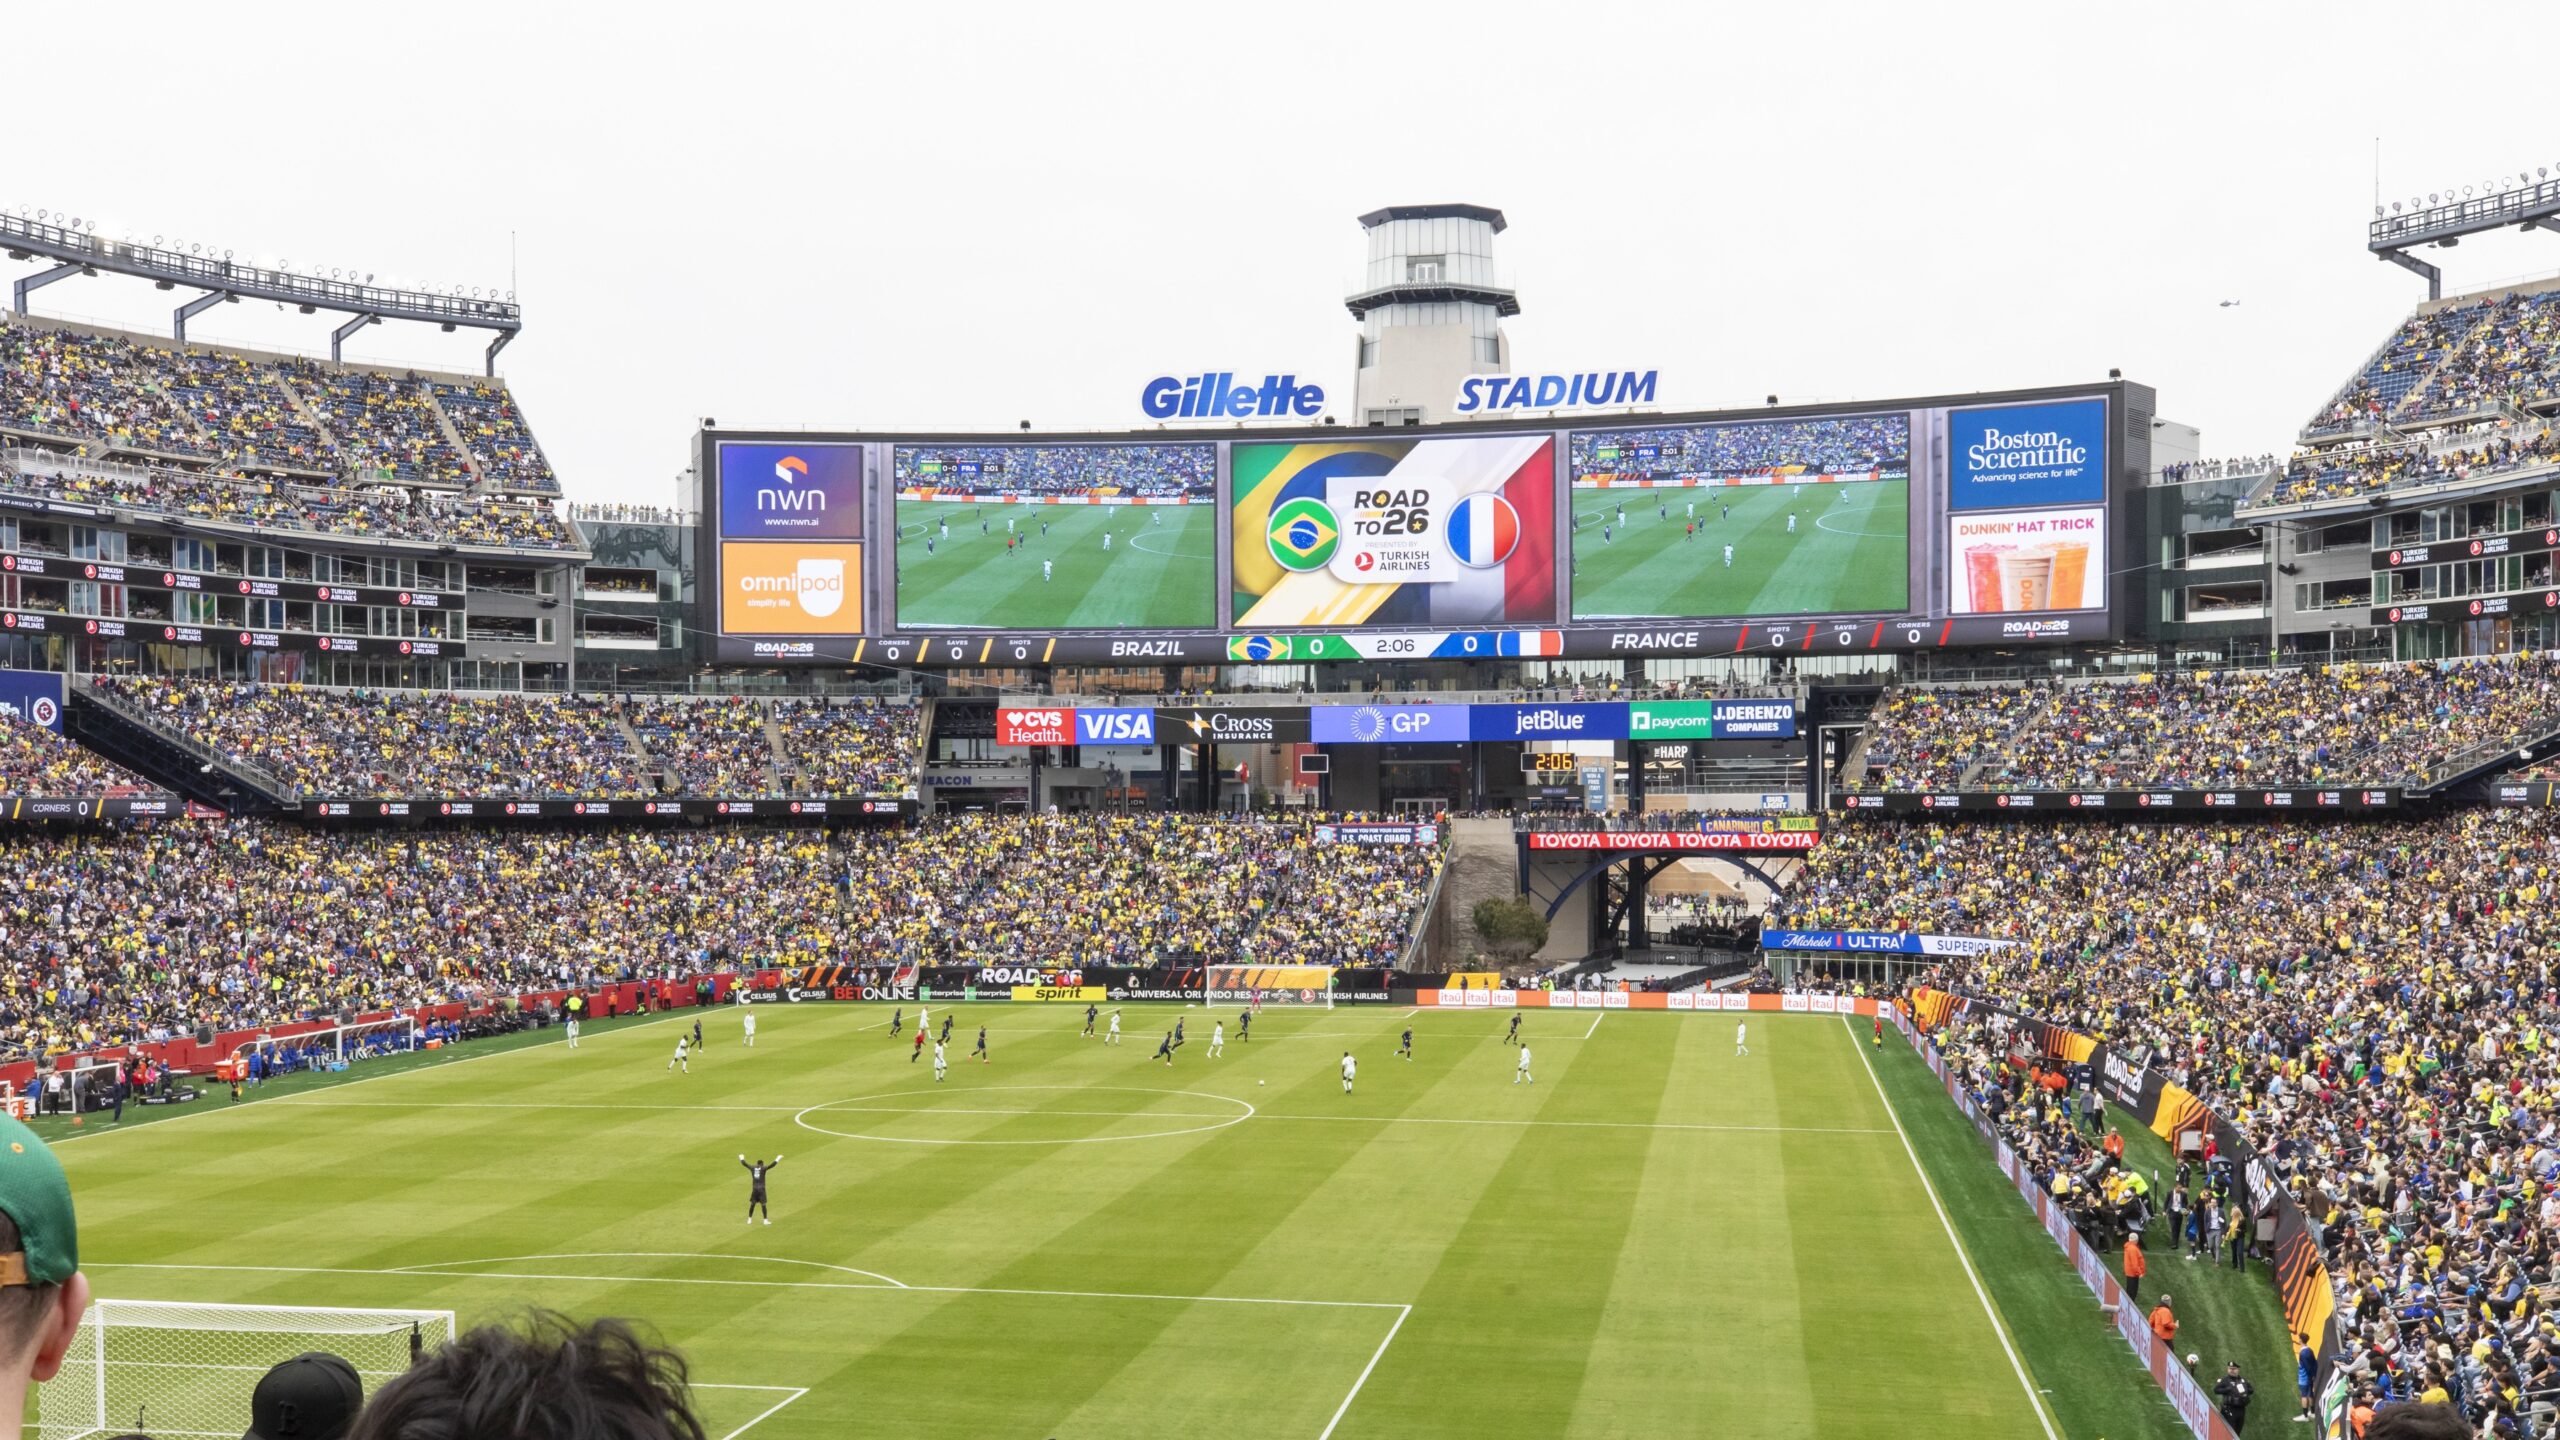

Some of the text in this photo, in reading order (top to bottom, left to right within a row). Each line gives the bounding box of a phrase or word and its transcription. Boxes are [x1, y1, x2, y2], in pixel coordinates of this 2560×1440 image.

[1142, 372, 1325, 418] Gillette
[1457, 371, 1658, 411] STADIUM
[1985, 428, 2058, 449] Boston
[1969, 439, 2086, 470] Scientific
[1972, 472, 2013, 483] Advancing
[2015, 470, 2047, 480] science
[2048, 468, 2061, 477] for
[757, 488, 825, 511] nwn
[1354, 490, 1430, 509] ROAD
[765, 517, 819, 527] www.nwn.ai
[1354, 520, 1381, 535] TO
[1960, 518, 2095, 535] DUNKIN' HAT TRICK
[2483, 538, 2508, 547] TURKISH
[2483, 544, 2508, 553] AIRLINES
[1379, 550, 1430, 560] TURKISH
[2402, 548, 2428, 557] TURKISH
[2402, 554, 2428, 563] AIRLINES
[16, 557, 44, 566] TURKISH
[1379, 560, 1430, 571] AIRLINES
[16, 564, 44, 573] AIRLINES
[97, 566, 124, 575] TURKISH
[97, 573, 124, 581] AIRLINES
[176, 574, 201, 583] TURKISH
[740, 572, 840, 594] omnipod
[176, 580, 201, 589] AIRLINES
[252, 582, 278, 590] TURKISH
[252, 588, 278, 596] AIRLINES
[747, 597, 791, 609] simplify life
[2483, 598, 2508, 607] TURKISH
[2483, 604, 2508, 613] AIRLINES
[16, 614, 45, 623] TURKISH
[16, 621, 45, 630] AIRLINES
[2003, 622, 2041, 632] ROAD
[1612, 632, 1699, 650] FRANCE
[1772, 634, 1784, 647] 0
[1839, 632, 1851, 645] 0
[1908, 630, 1920, 643] 0
[754, 643, 789, 652] ROAD
[1111, 641, 1185, 656] BRAZIL
[1310, 638, 1324, 655] 0
[1376, 638, 1415, 654] 2:06
[1464, 636, 1478, 652] 0
[887, 647, 899, 660] 0
[951, 647, 963, 660] 0
[1015, 647, 1027, 660] 0
[1025, 712, 1063, 727] CVS
[1713, 705, 1793, 721] J.DERENZO
[1078, 713, 1152, 739] VISA
[1516, 709, 1585, 735] jetBlue
[1652, 715, 1708, 730] paycom
[1726, 722, 1779, 733] COMPANIES
[1213, 732, 1273, 740] INSURANCE
[1660, 745, 1688, 759] HARP
[1536, 753, 1573, 770] 2:06
[33, 802, 88, 815] CORNERS 0
[131, 802, 151, 810] ROAD
[1706, 819, 1760, 833] CANARINHO
[1786, 819, 1811, 829] MVA
[1358, 835, 1382, 843] COAST
[1384, 834, 1411, 843] GUARD
[1537, 834, 1813, 847] TOYOTA TOYOTA TOYOTA TOYOTA
[1782, 933, 1900, 949] Michelob ULTRA
[982, 968, 1039, 984] ROAD
[800, 990, 826, 998] CELSIUS
[1035, 986, 1081, 1000] spirit
[1131, 990, 1183, 999] UNIVERSAL
[1234, 990, 1269, 999] RESRT
[1318, 992, 1388, 1000] TURKISH AIRLINES
[236, 1063, 245, 1077] G
[2104, 1052, 2128, 1084] ROAD
[10, 1102, 19, 1117] G
